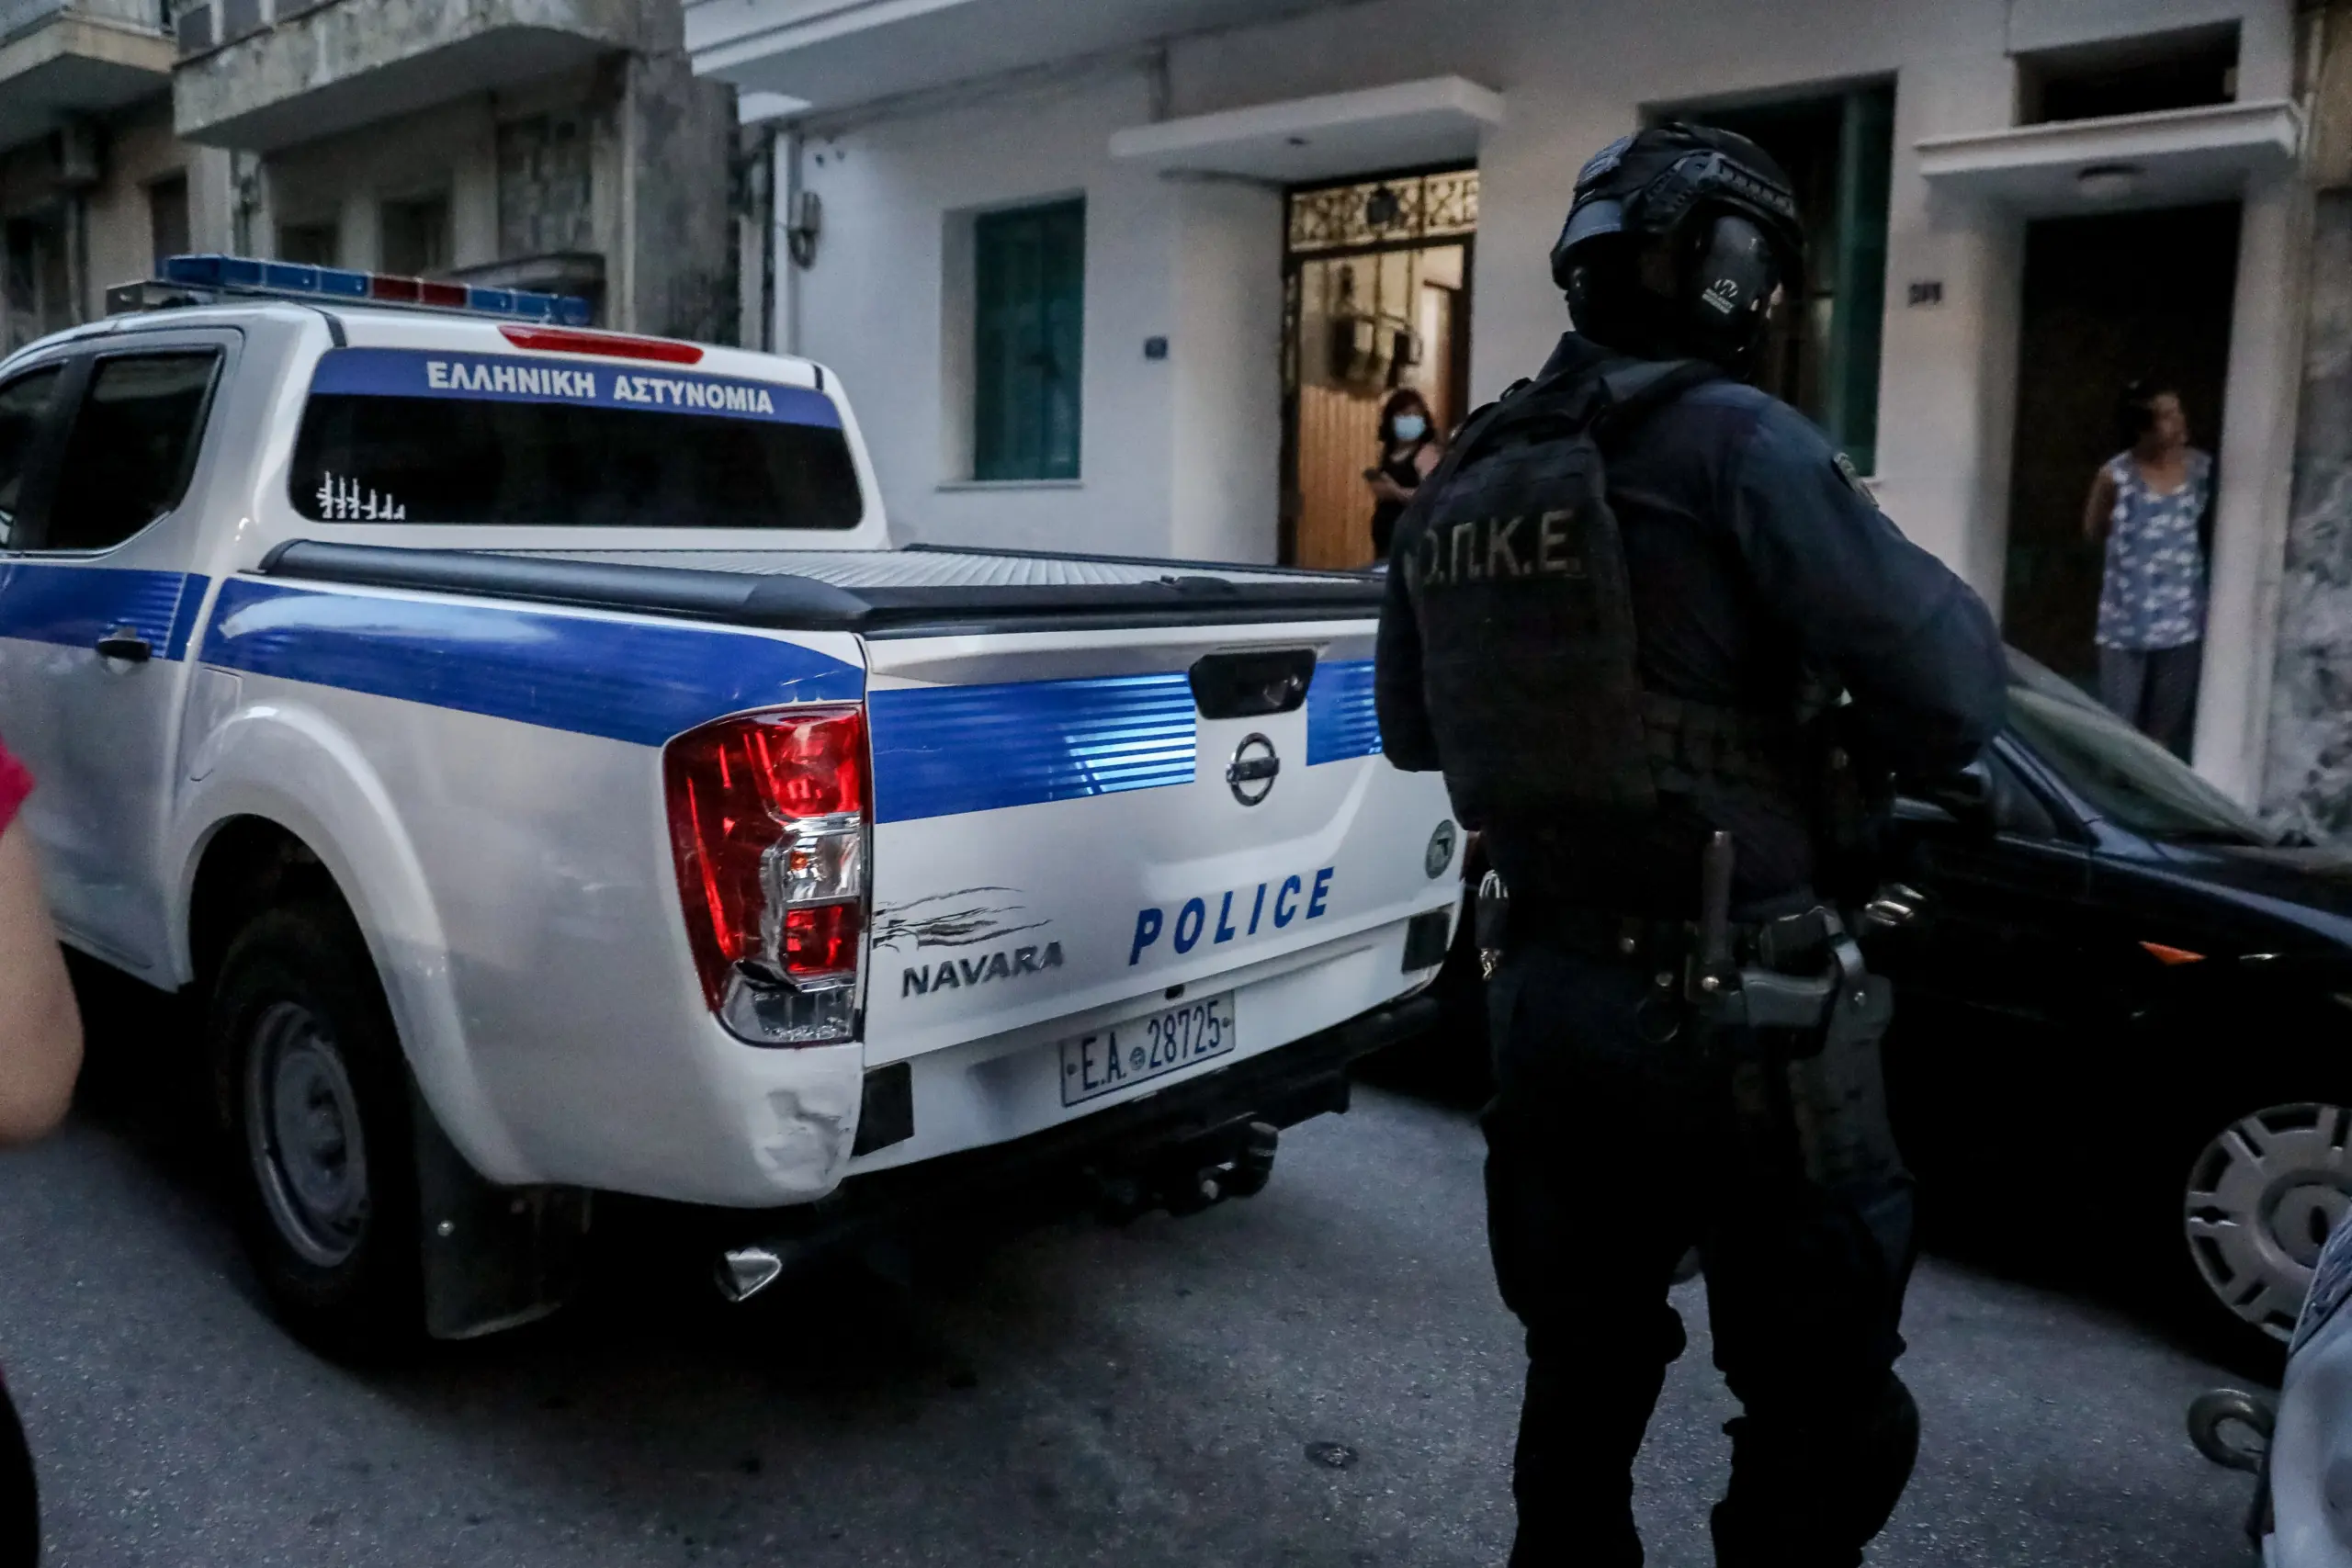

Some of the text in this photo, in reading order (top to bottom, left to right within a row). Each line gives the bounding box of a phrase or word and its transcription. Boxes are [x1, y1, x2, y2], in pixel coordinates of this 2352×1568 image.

[426, 361, 775, 415] ΕΛΛΗΝΙΚΗ ΑΣΤΥΝΟΜΙΑ
[1128, 867, 1336, 966] POLICE
[901, 941, 1064, 998] NAVARA
[1148, 999, 1221, 1069] 28725
